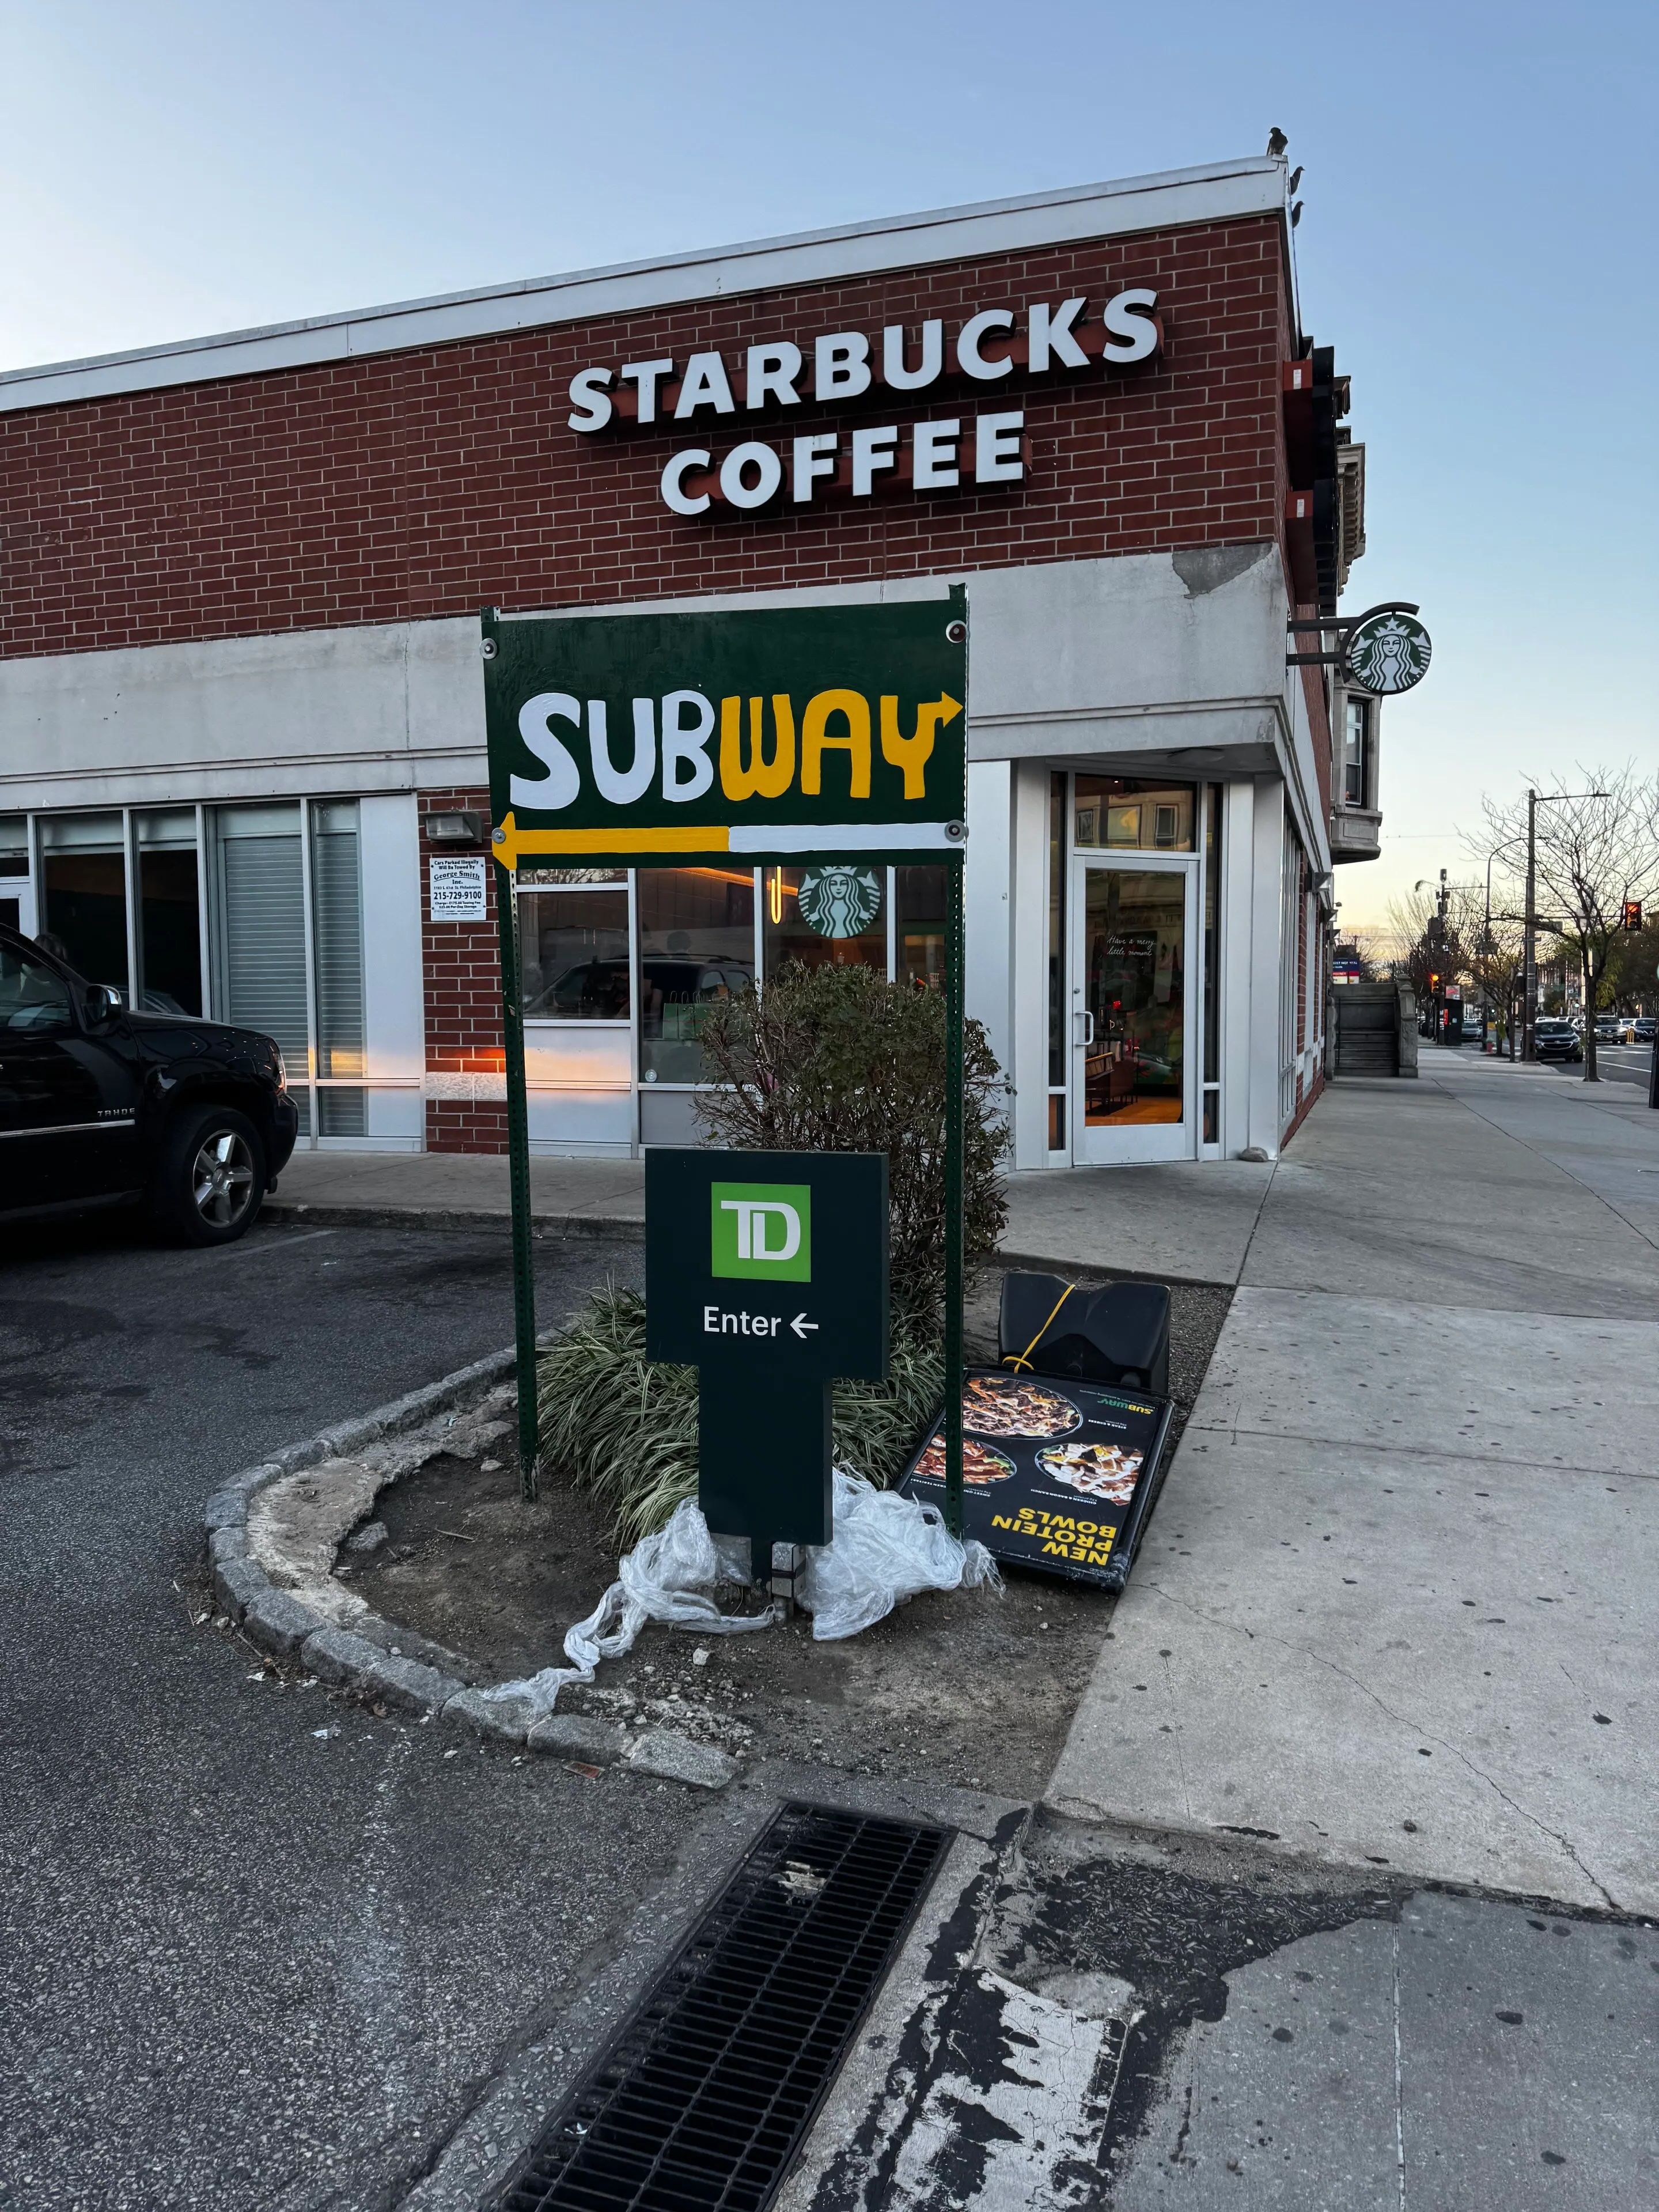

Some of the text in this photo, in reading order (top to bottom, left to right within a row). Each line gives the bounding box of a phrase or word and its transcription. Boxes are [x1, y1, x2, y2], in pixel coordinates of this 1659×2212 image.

[568, 288, 1159, 433] STARBUCKS
[661, 411, 1025, 515] COFFEE
[510, 689, 964, 809] SUBWAY
[434, 871, 480, 880] George Smith
[434, 891, 482, 900] 215-729-9100
[1107, 935, 1126, 944] Have
[1137, 940, 1157, 949] merry
[1107, 946, 1125, 955] little
[97, 1108, 135, 1118] TAHOE
[721, 1200, 801, 1260] TD
[704, 1306, 781, 1336] Enter
[1097, 1398, 1154, 1414] SUBWAY
[991, 1515, 1113, 1552] PROTEIN
[1018, 1508, 1117, 1539] BOWLS
[1041, 1541, 1108, 1566] NEW
